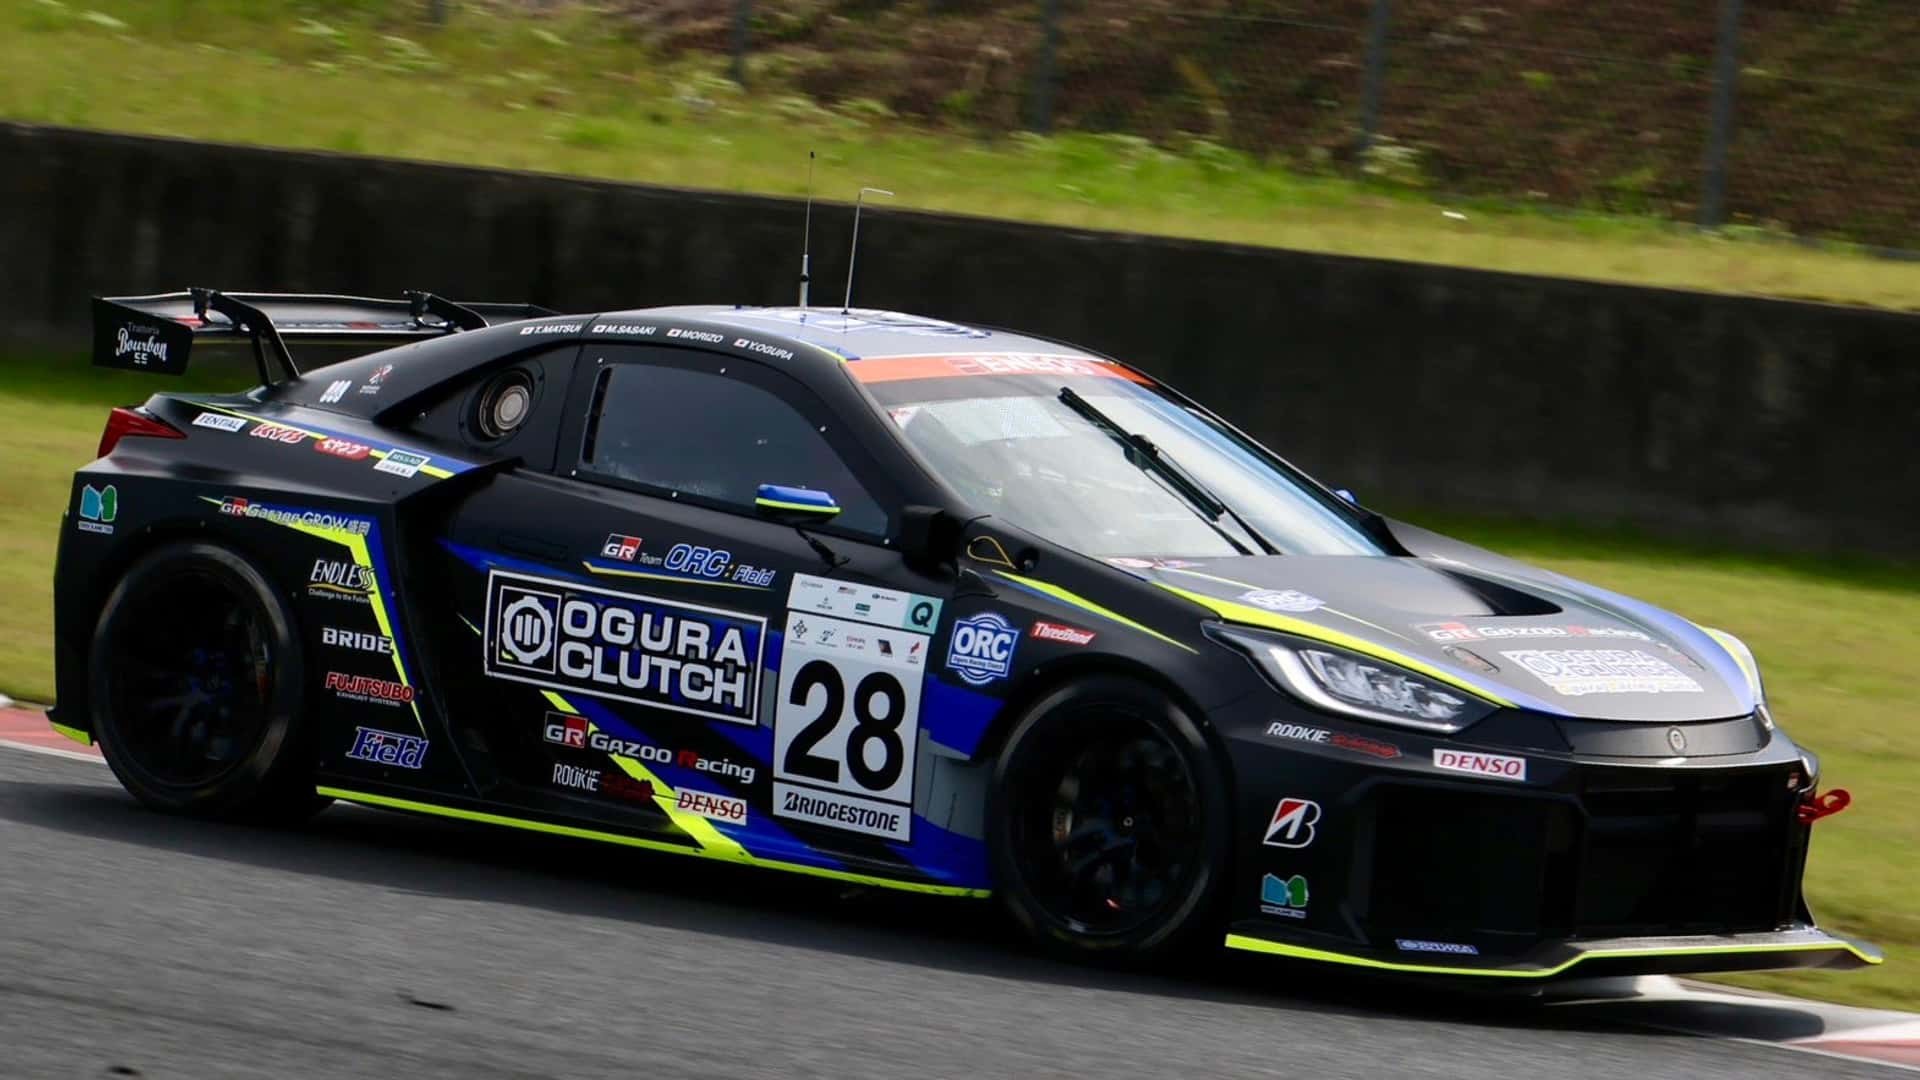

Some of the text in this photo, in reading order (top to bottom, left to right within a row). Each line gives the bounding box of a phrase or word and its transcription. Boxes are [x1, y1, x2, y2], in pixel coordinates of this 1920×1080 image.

[115, 327, 167, 361] Bourbon
[607, 325, 656, 336] M.SASAKI
[680, 329, 723, 343] MORIZO
[605, 543, 634, 560] GR
[640, 551, 662, 566] Team
[310, 559, 374, 590] ENDLESS
[911, 602, 934, 627] Q
[322, 627, 392, 654] BRIDE
[562, 600, 747, 667] OGURA
[954, 627, 1011, 660] ORC
[326, 671, 414, 702] FUJITSUBO
[560, 641, 744, 708] CLUTCH
[784, 660, 906, 791] 28
[1266, 721, 1330, 743] ROOKIE
[346, 726, 429, 769] Field
[546, 724, 584, 746] GR
[677, 749, 755, 784] Racing
[552, 763, 600, 791] ROOKIE
[1440, 752, 1521, 776] DENSO
[678, 791, 744, 819] DENSO
[784, 791, 900, 832] BRIDGESTONE
